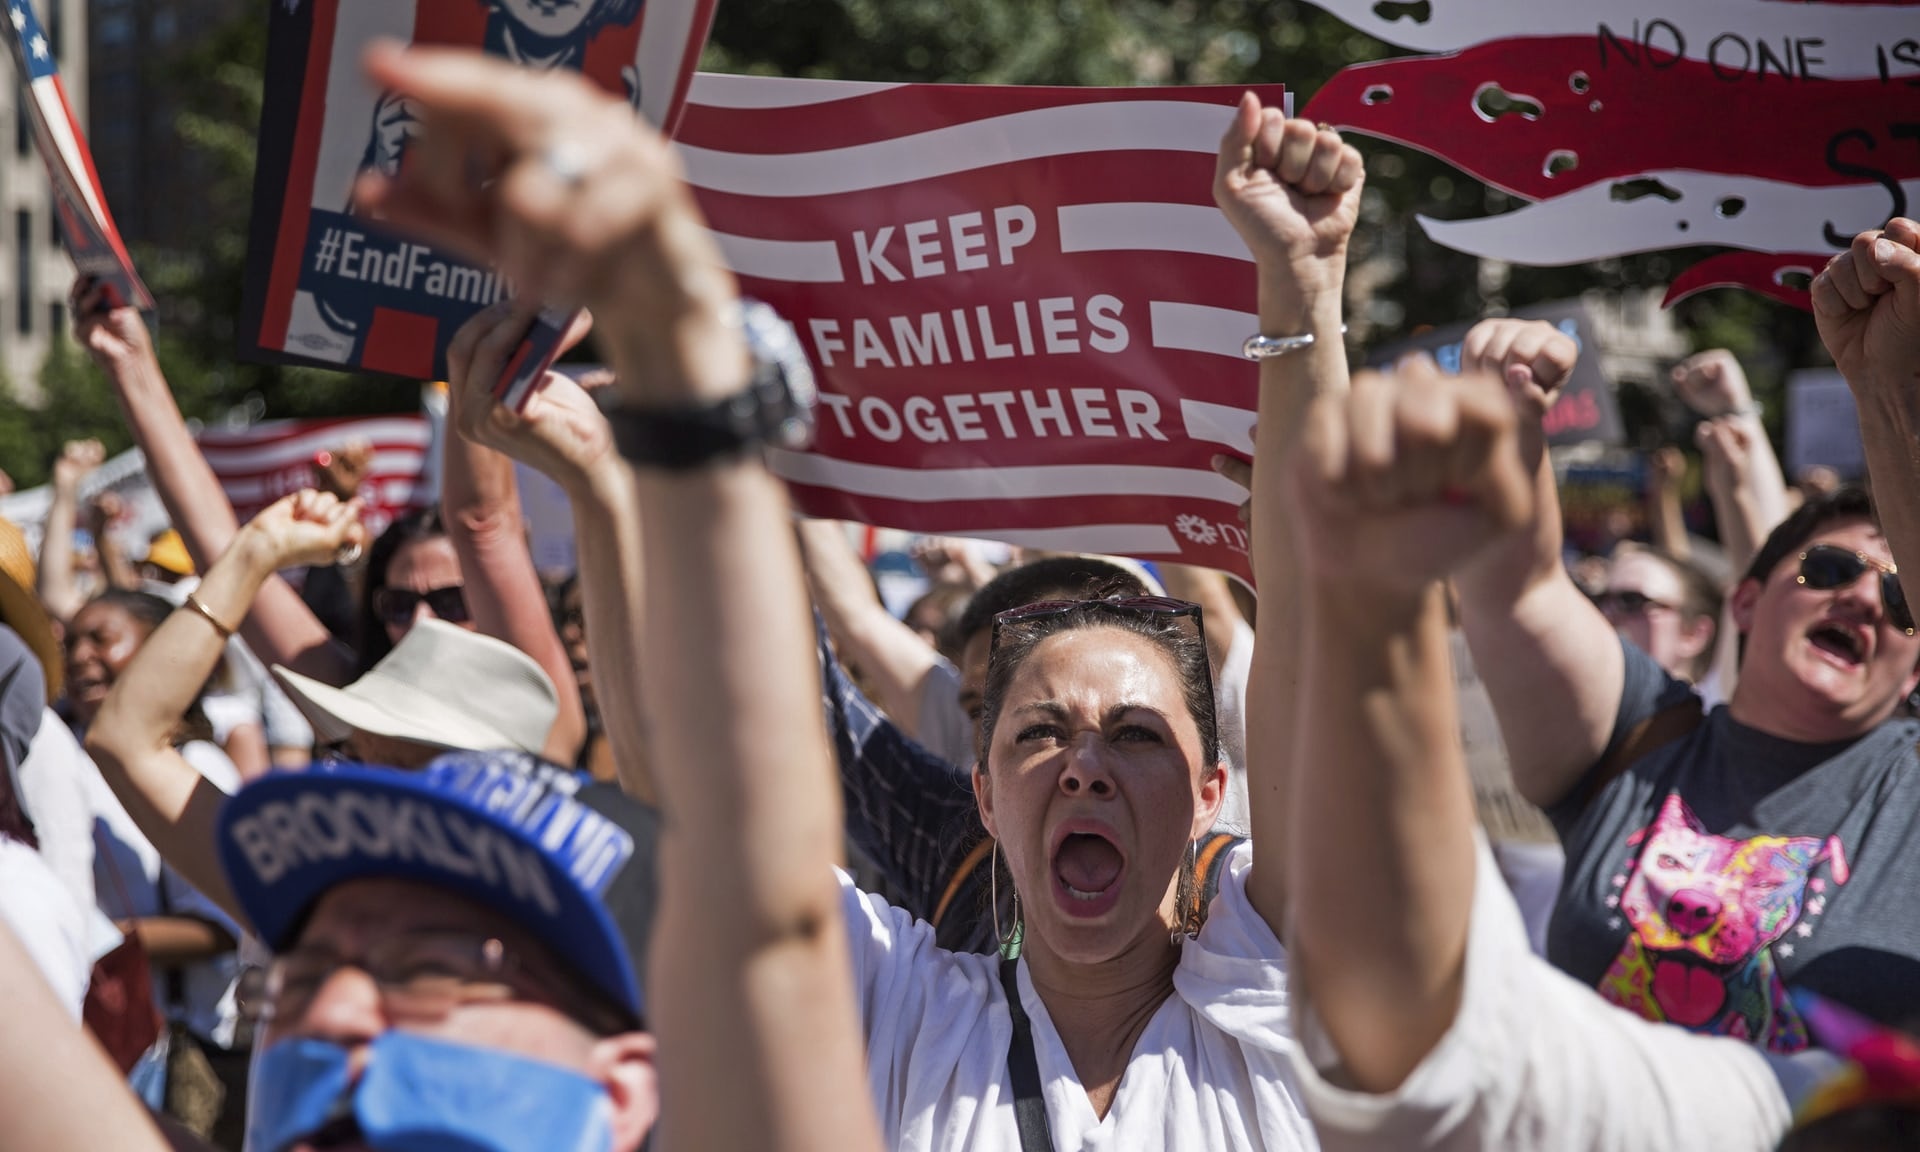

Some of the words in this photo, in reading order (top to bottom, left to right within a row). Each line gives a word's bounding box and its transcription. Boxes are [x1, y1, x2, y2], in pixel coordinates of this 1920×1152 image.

[1598, 19, 1685, 70] NO
[1708, 32, 1825, 81] ONE
[1877, 38, 1920, 87] IS
[1823, 122, 1920, 248] S
[853, 204, 1037, 285] KEEP
[809, 294, 1130, 369] FAMILIES
[816, 388, 1169, 442] TOGETHER
[231, 789, 561, 915] BROOKLYN
